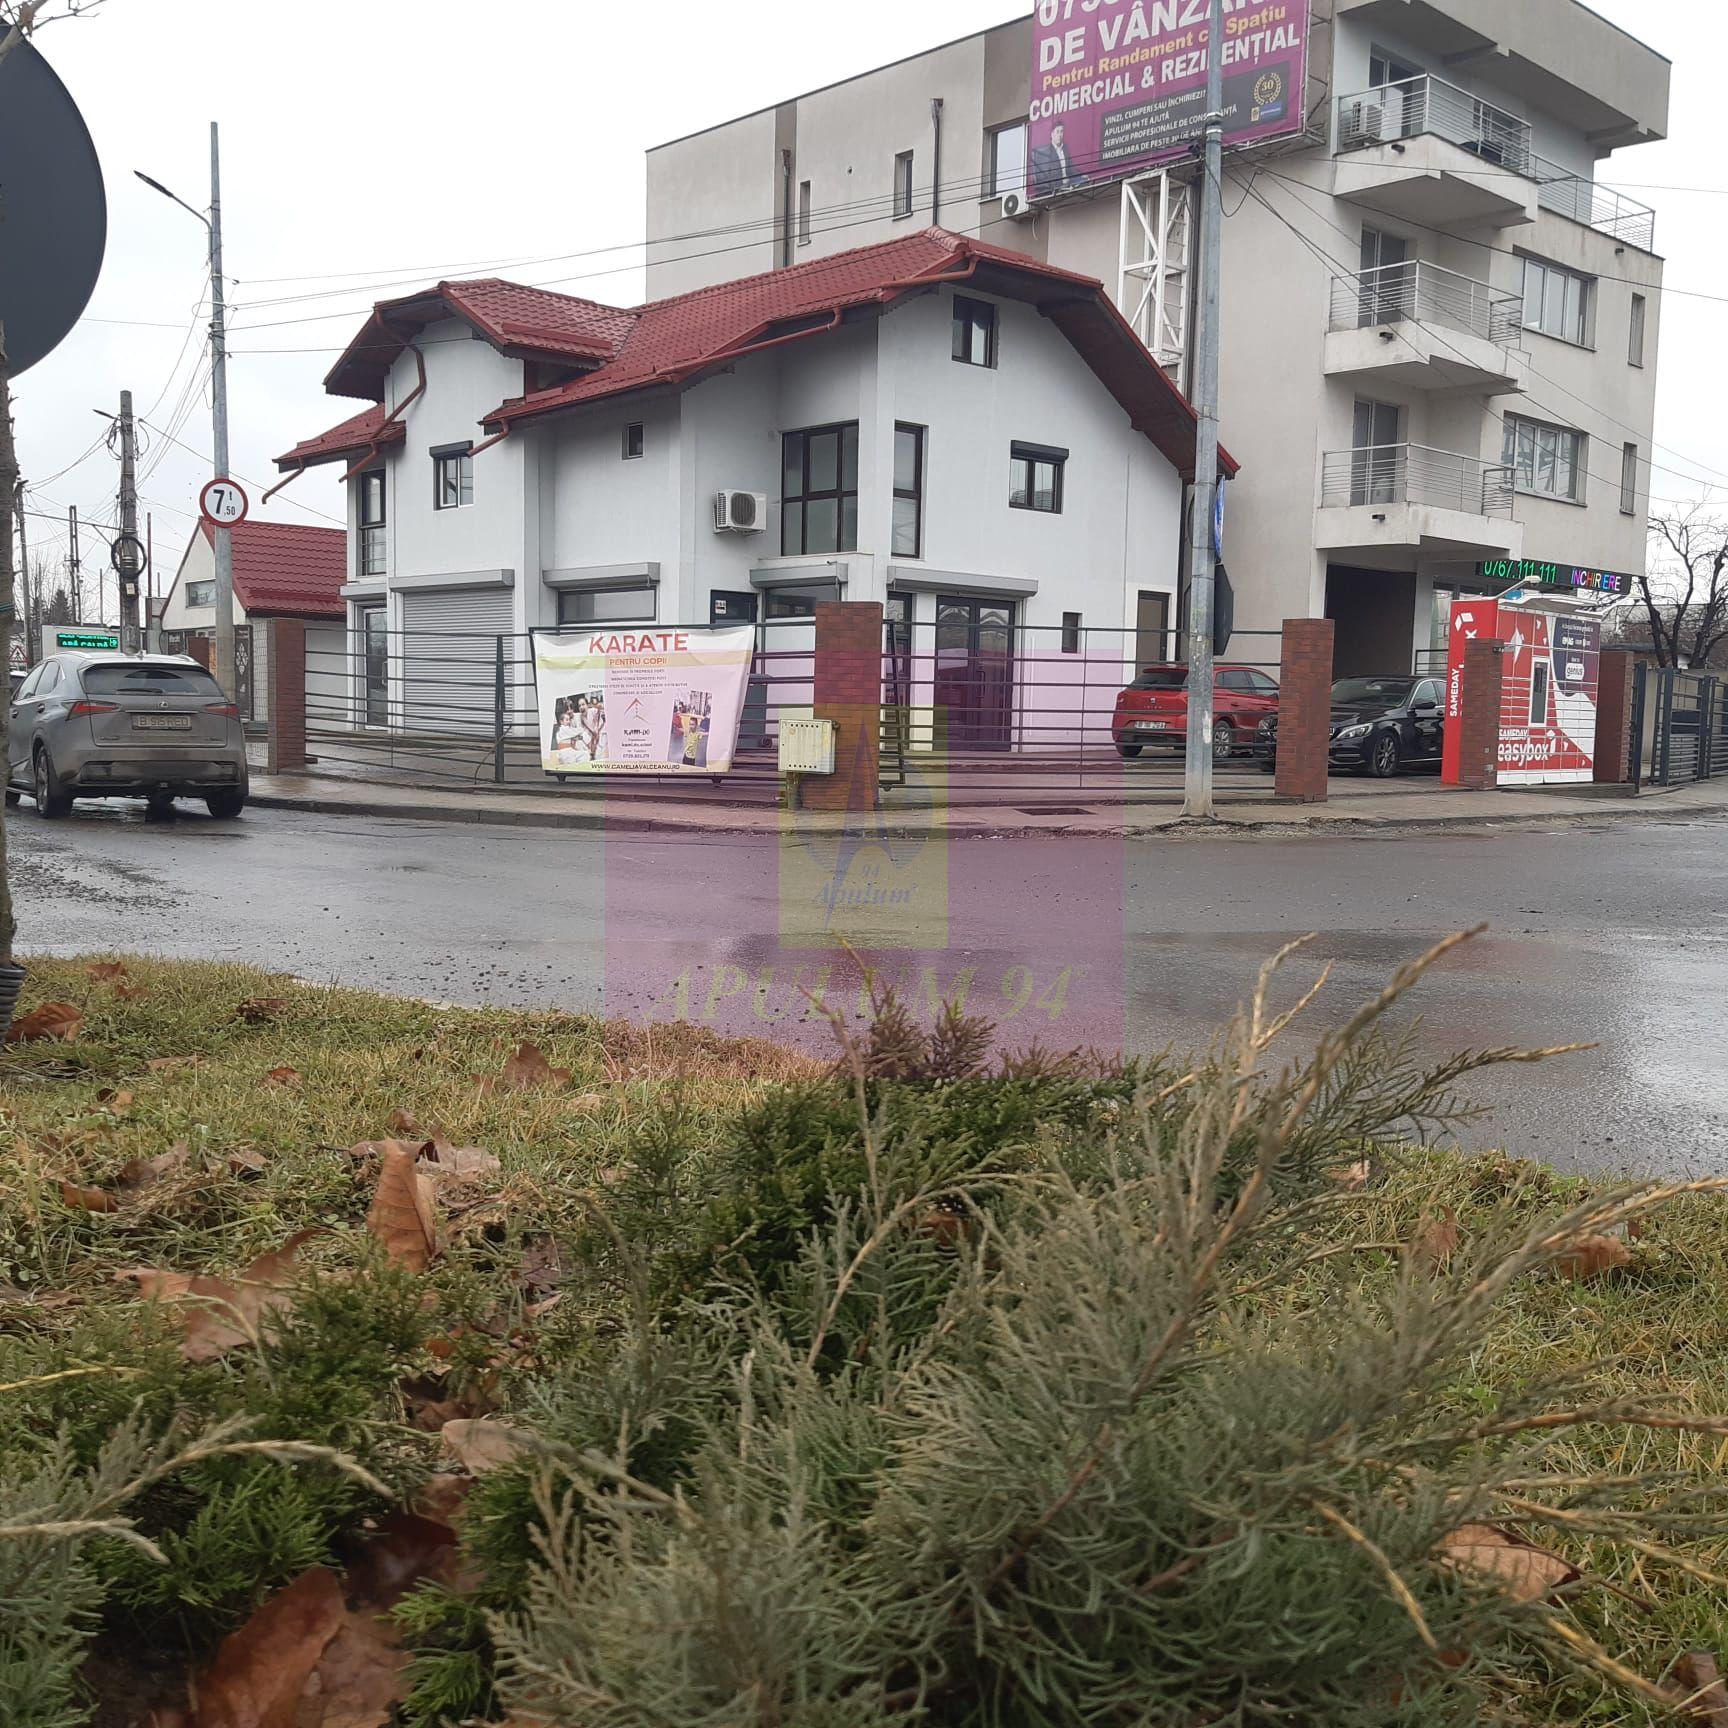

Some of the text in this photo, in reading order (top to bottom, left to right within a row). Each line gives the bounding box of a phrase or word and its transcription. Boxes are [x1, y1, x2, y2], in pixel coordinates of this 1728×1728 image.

[1039, 27, 1086, 72] DE
[1042, 65, 1094, 91] Pentru
[1098, 31, 1194, 74] Randament
[1225, 6, 1286, 35] Spațiu
[1029, 23, 1300, 121] COMERCIAL & REZIENȚIAL
[1261, 79, 1274, 91] 30
[1153, 101, 1167, 111] SAU
[1104, 123, 1132, 137] APULUM
[1141, 117, 1150, 127] TE
[1130, 120, 1178, 141] PROFESIONALE
[1178, 118, 1189, 128] DE
[1140, 141, 1150, 152] DE
[1150, 135, 1171, 149] PESTE
[213, 489, 225, 514] 7
[588, 633, 689, 653] KARATE
[609, 656, 668, 667] PENTRU COPII
[1449, 668, 1460, 717] SAMEDAY
[1498, 728, 1528, 741] SAMEDAY
[1497, 743, 1549, 767] easybox
